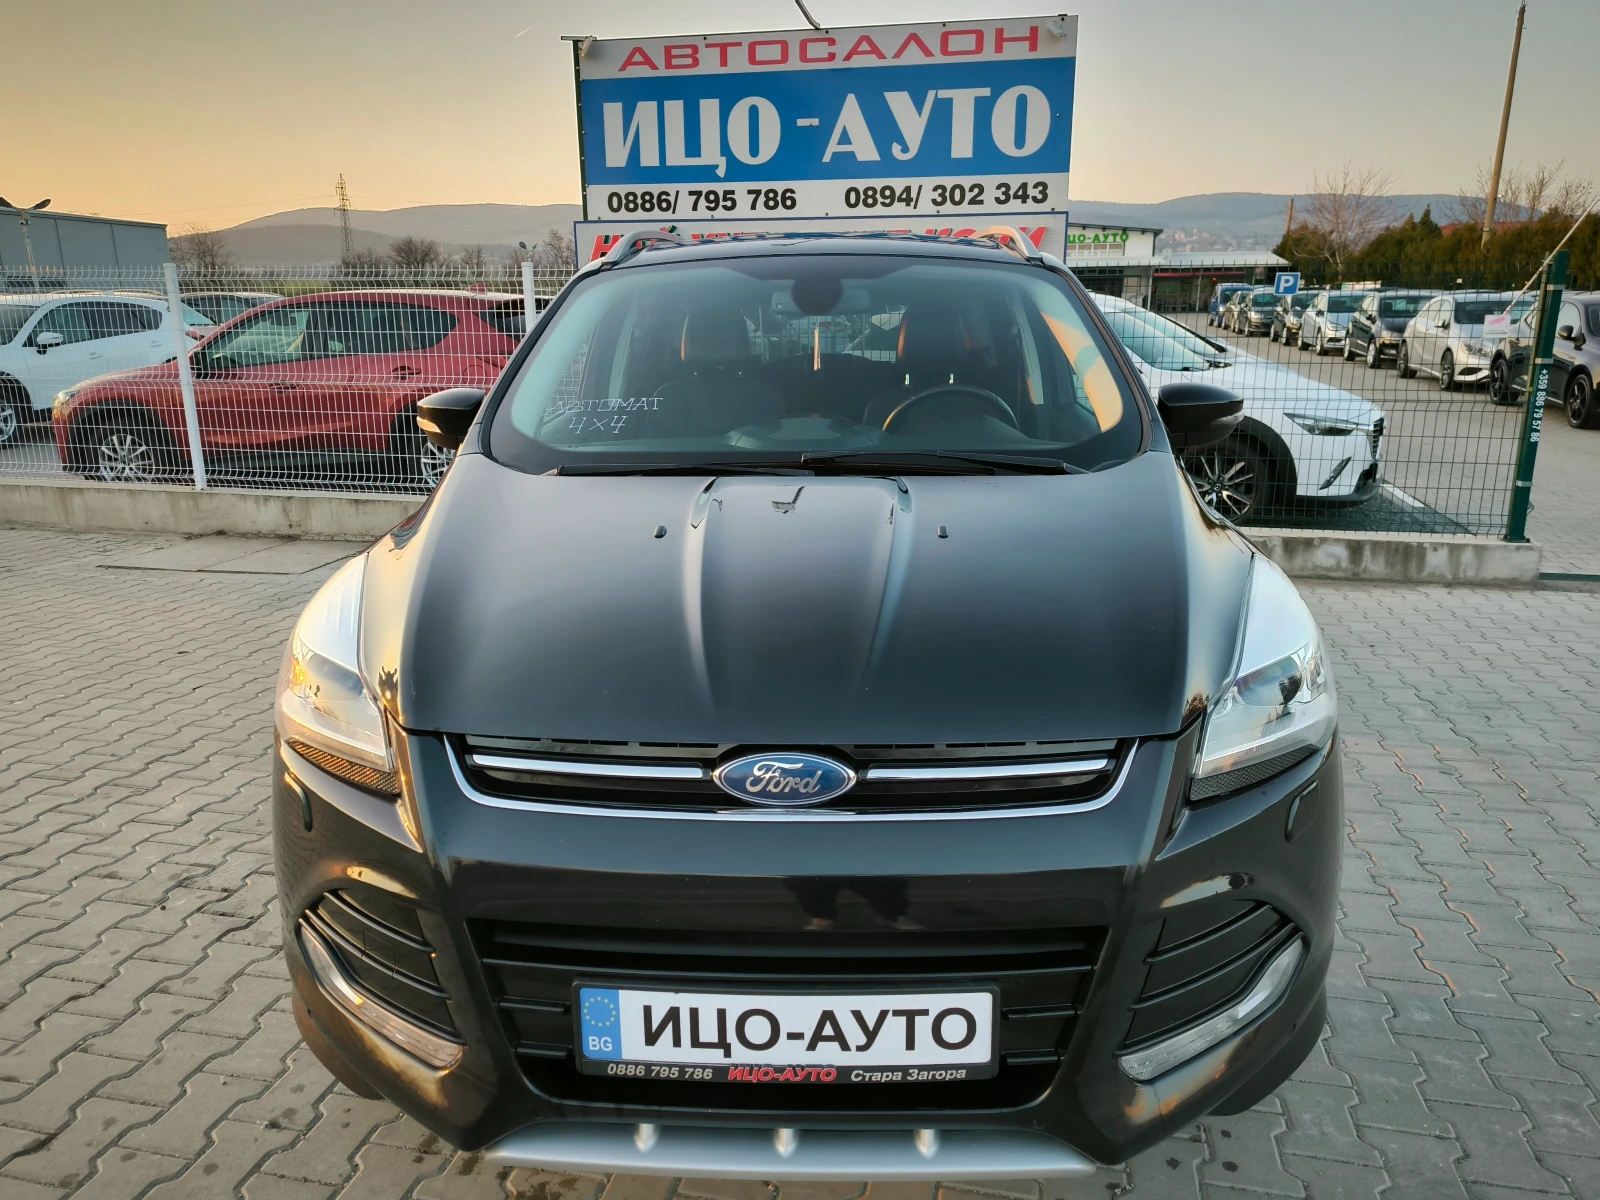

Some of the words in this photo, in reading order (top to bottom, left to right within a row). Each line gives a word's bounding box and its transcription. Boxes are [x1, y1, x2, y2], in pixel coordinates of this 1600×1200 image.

[618, 26, 1039, 72] АВТОСАЛОН
[607, 191, 680, 214] 0886/
[688, 190, 737, 212] 795
[746, 188, 797, 211] 786
[844, 185, 923, 209] 0894/
[931, 183, 985, 206] 302
[994, 181, 1049, 204] 343
[1279, 276, 1294, 292] P
[1538, 369, 1549, 389] +359
[541, 397, 664, 416] АВТОМАТ
[1535, 391, 1546, 406] 886
[1533, 408, 1543, 418] 79
[1531, 420, 1541, 430] 57
[1530, 432, 1540, 442] 86
[745, 761, 822, 794] Ford
[643, 1004, 977, 1059] ИЦО-АУТО
[588, 1035, 613, 1051] BG
[607, 1063, 645, 1076] 0886
[650, 1065, 679, 1078] 795
[684, 1067, 713, 1080] 786
[727, 1066, 837, 1083] ИЦО-АУТО
[850, 1069, 902, 1083] Стара
[907, 1069, 967, 1083] Загора
